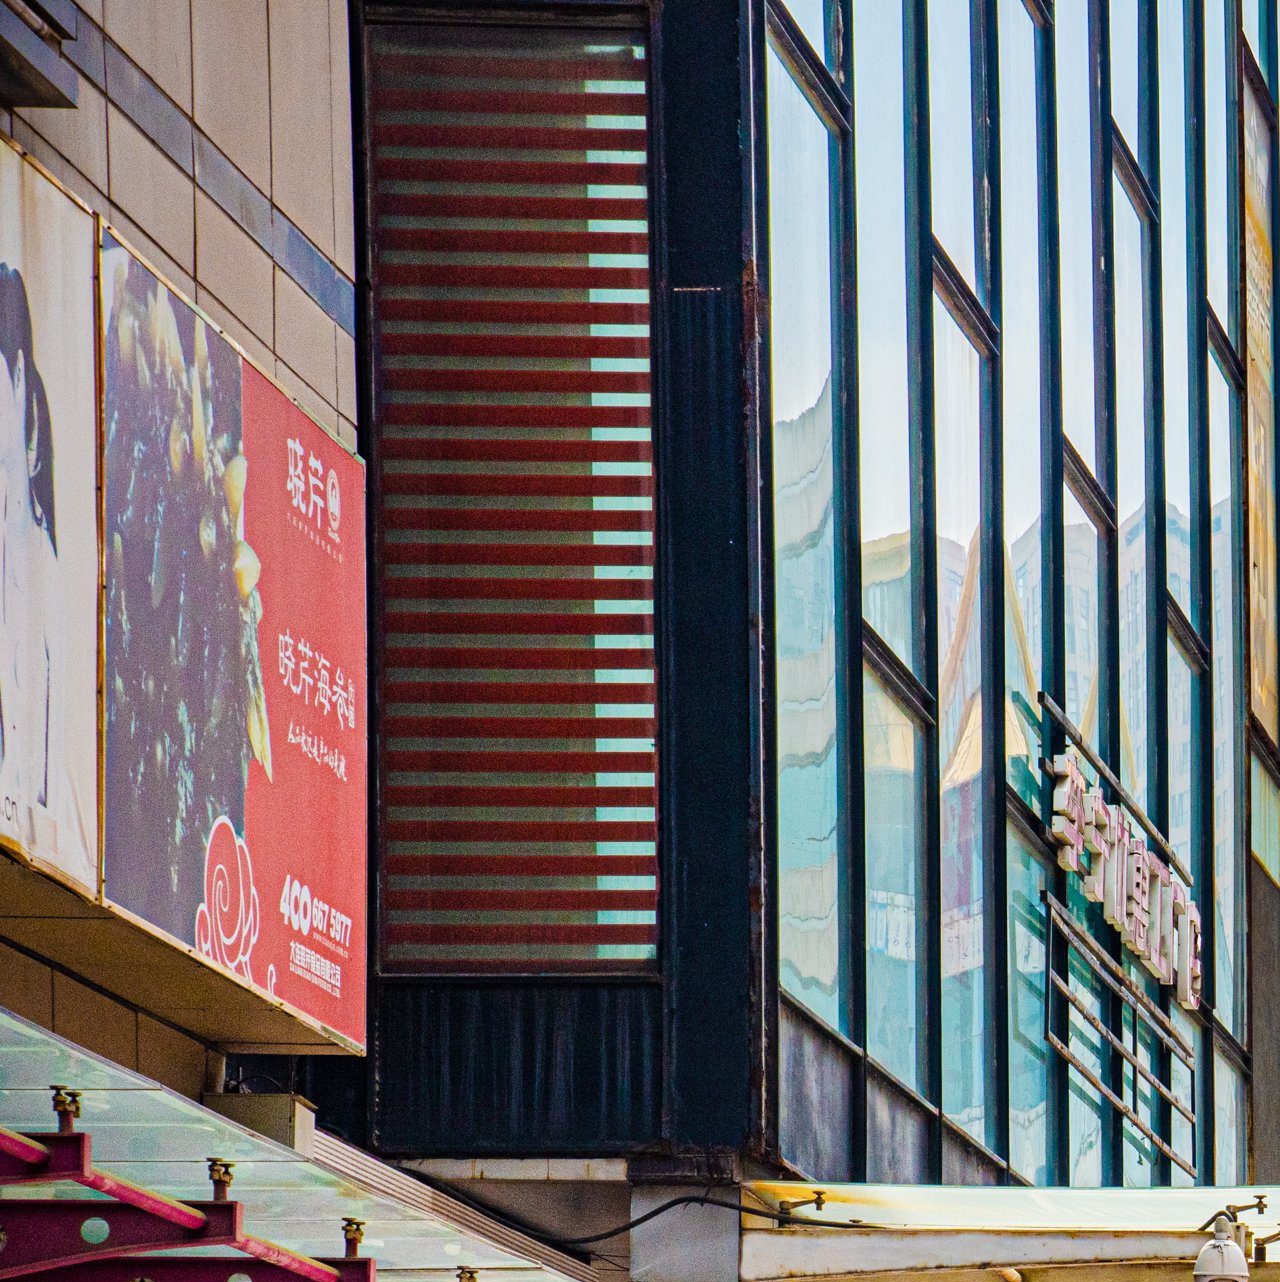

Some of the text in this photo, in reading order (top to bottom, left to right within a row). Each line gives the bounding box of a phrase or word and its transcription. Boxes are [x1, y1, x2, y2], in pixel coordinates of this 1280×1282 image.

[287, 438, 324, 529] 晓芹
[279, 628, 350, 730] 晓芹海参
[280, 874, 311, 935] 400
[313, 897, 329, 933] 667
[330, 907, 352, 948] 5977
